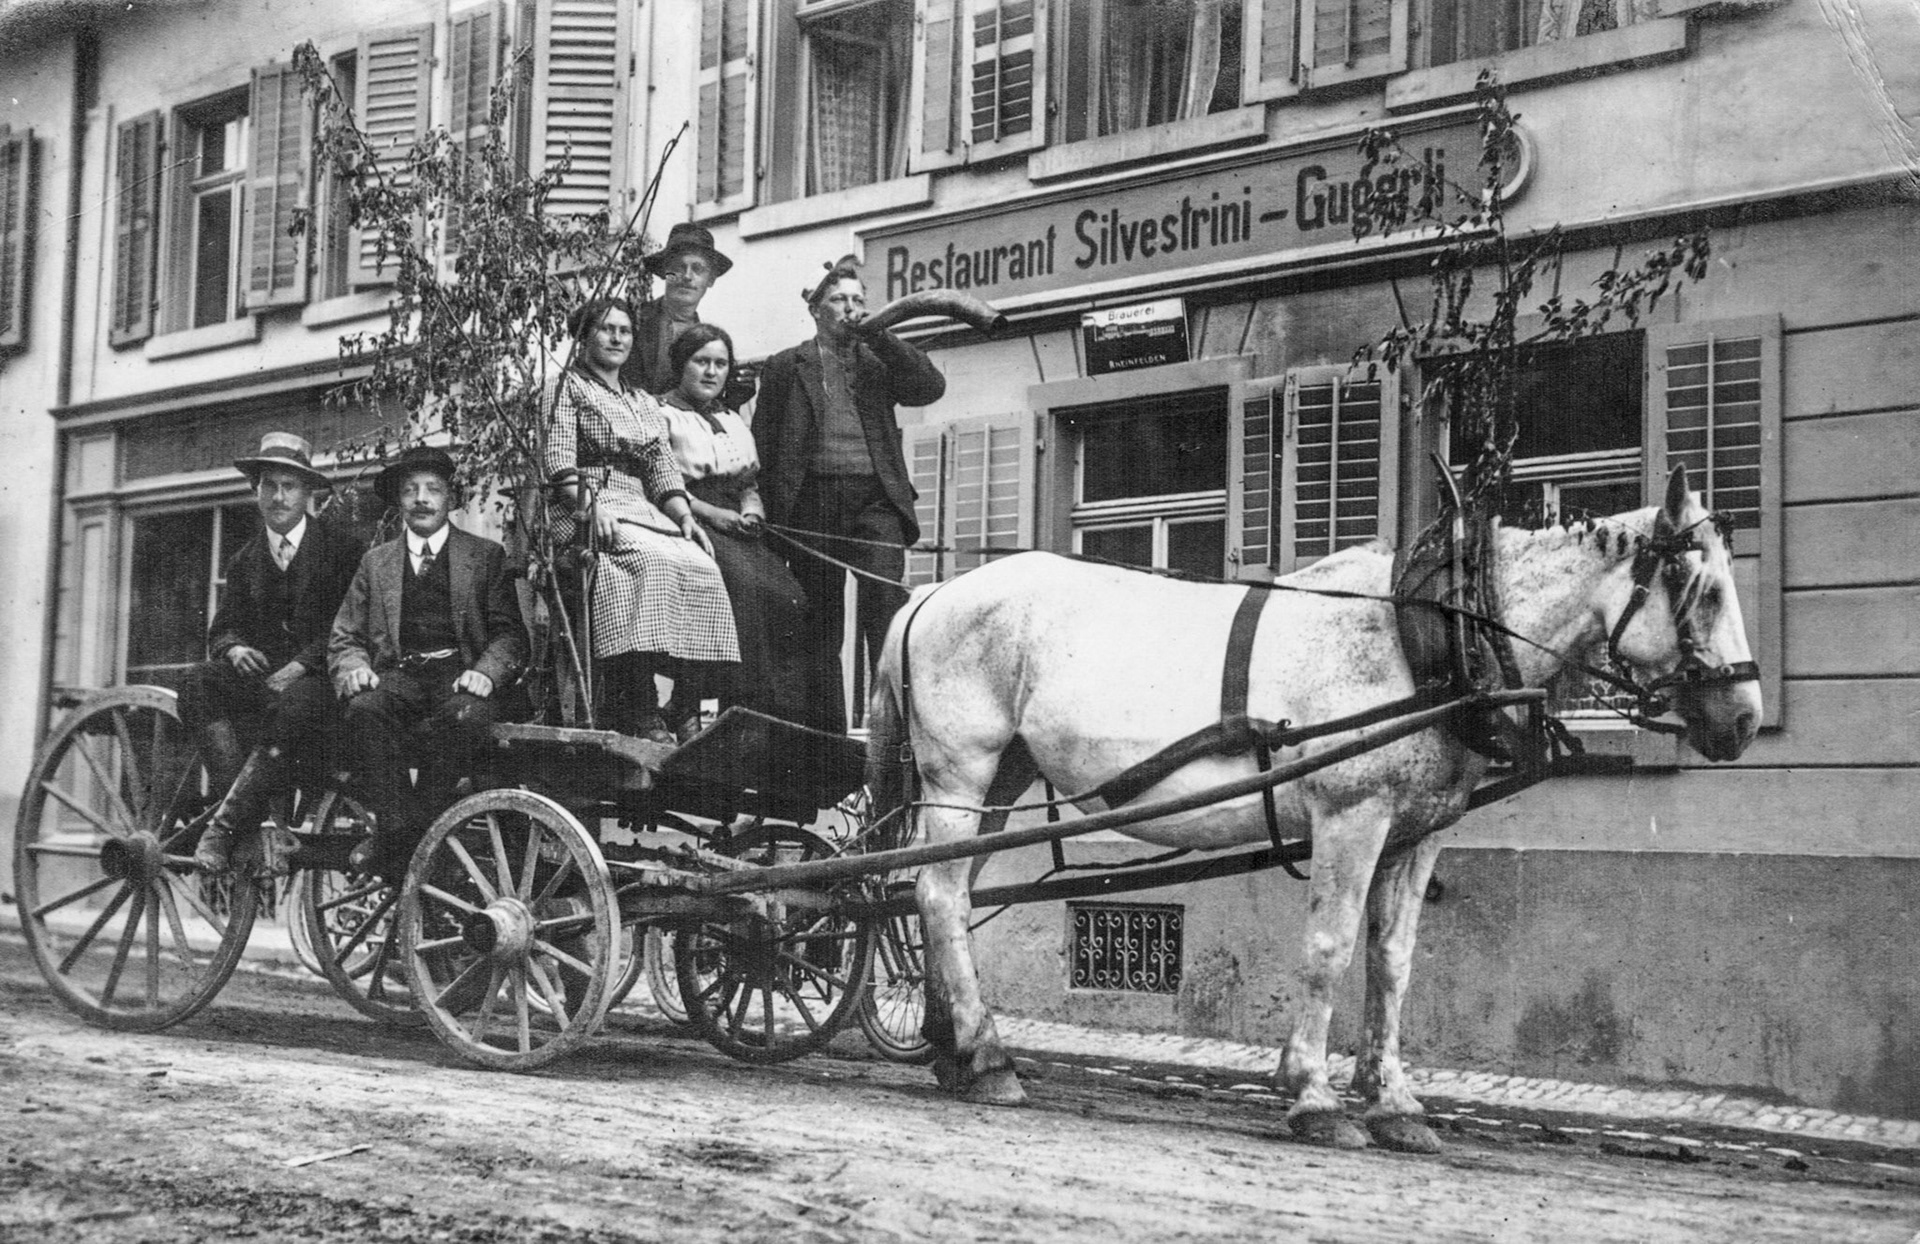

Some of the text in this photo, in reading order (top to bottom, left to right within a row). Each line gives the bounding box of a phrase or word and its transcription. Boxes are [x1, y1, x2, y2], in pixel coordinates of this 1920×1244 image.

[886, 223, 1057, 303] Restaurant
[1074, 184, 1252, 269] Silvestrini
[1107, 306, 1155, 322] Brauerei
